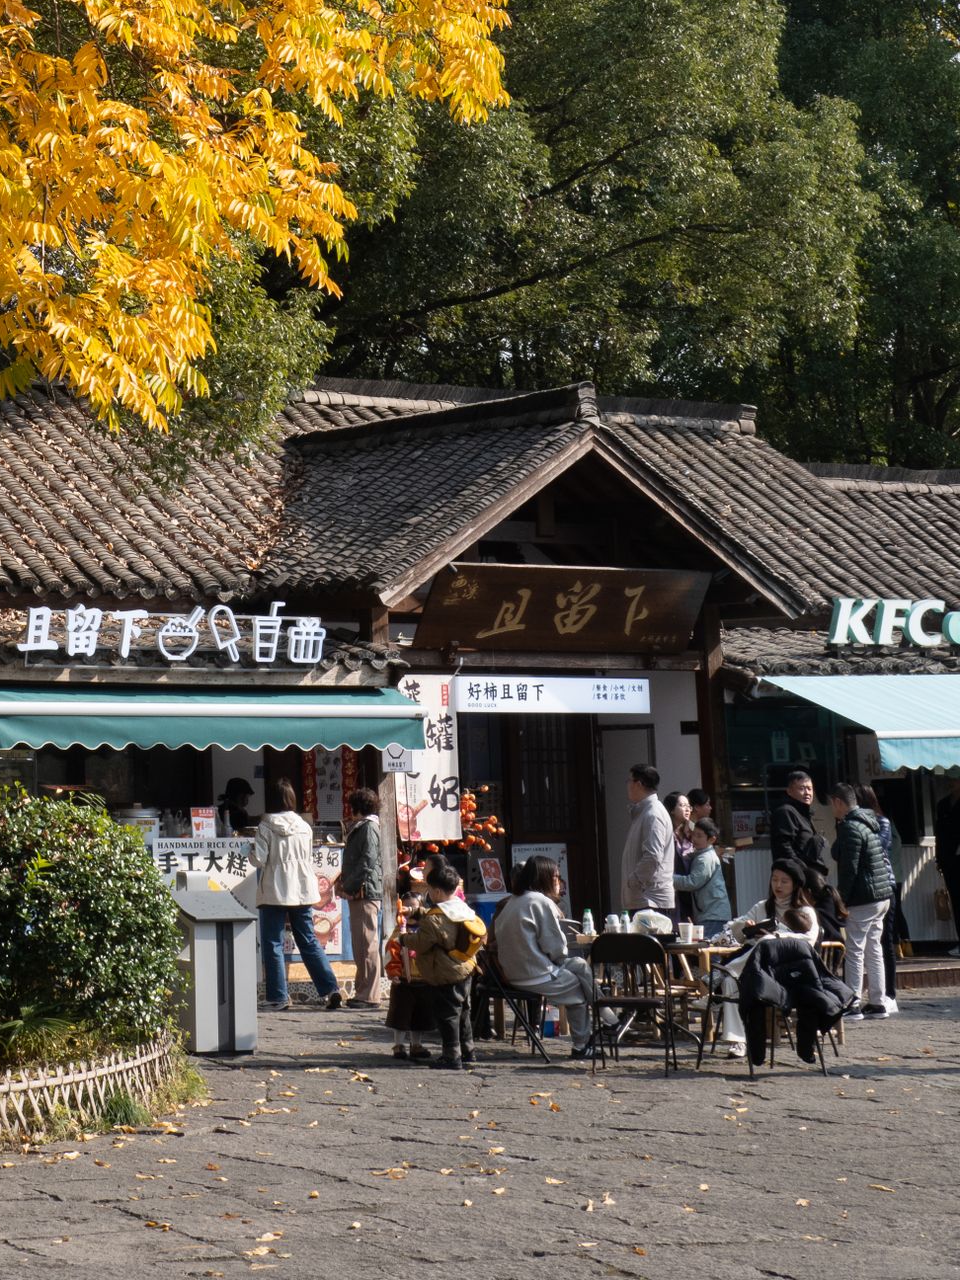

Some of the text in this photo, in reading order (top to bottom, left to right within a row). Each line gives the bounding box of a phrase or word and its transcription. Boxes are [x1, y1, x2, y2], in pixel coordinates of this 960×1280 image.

[476, 580, 649, 638] 且留下
[828, 597, 945, 647] KFC
[17, 603, 149, 658] 且留下
[467, 681, 545, 702] 好柿且留下
[157, 841, 204, 849] HANDMADE
[207, 841, 227, 849] RICE
[158, 850, 248, 878] 手工大糕
